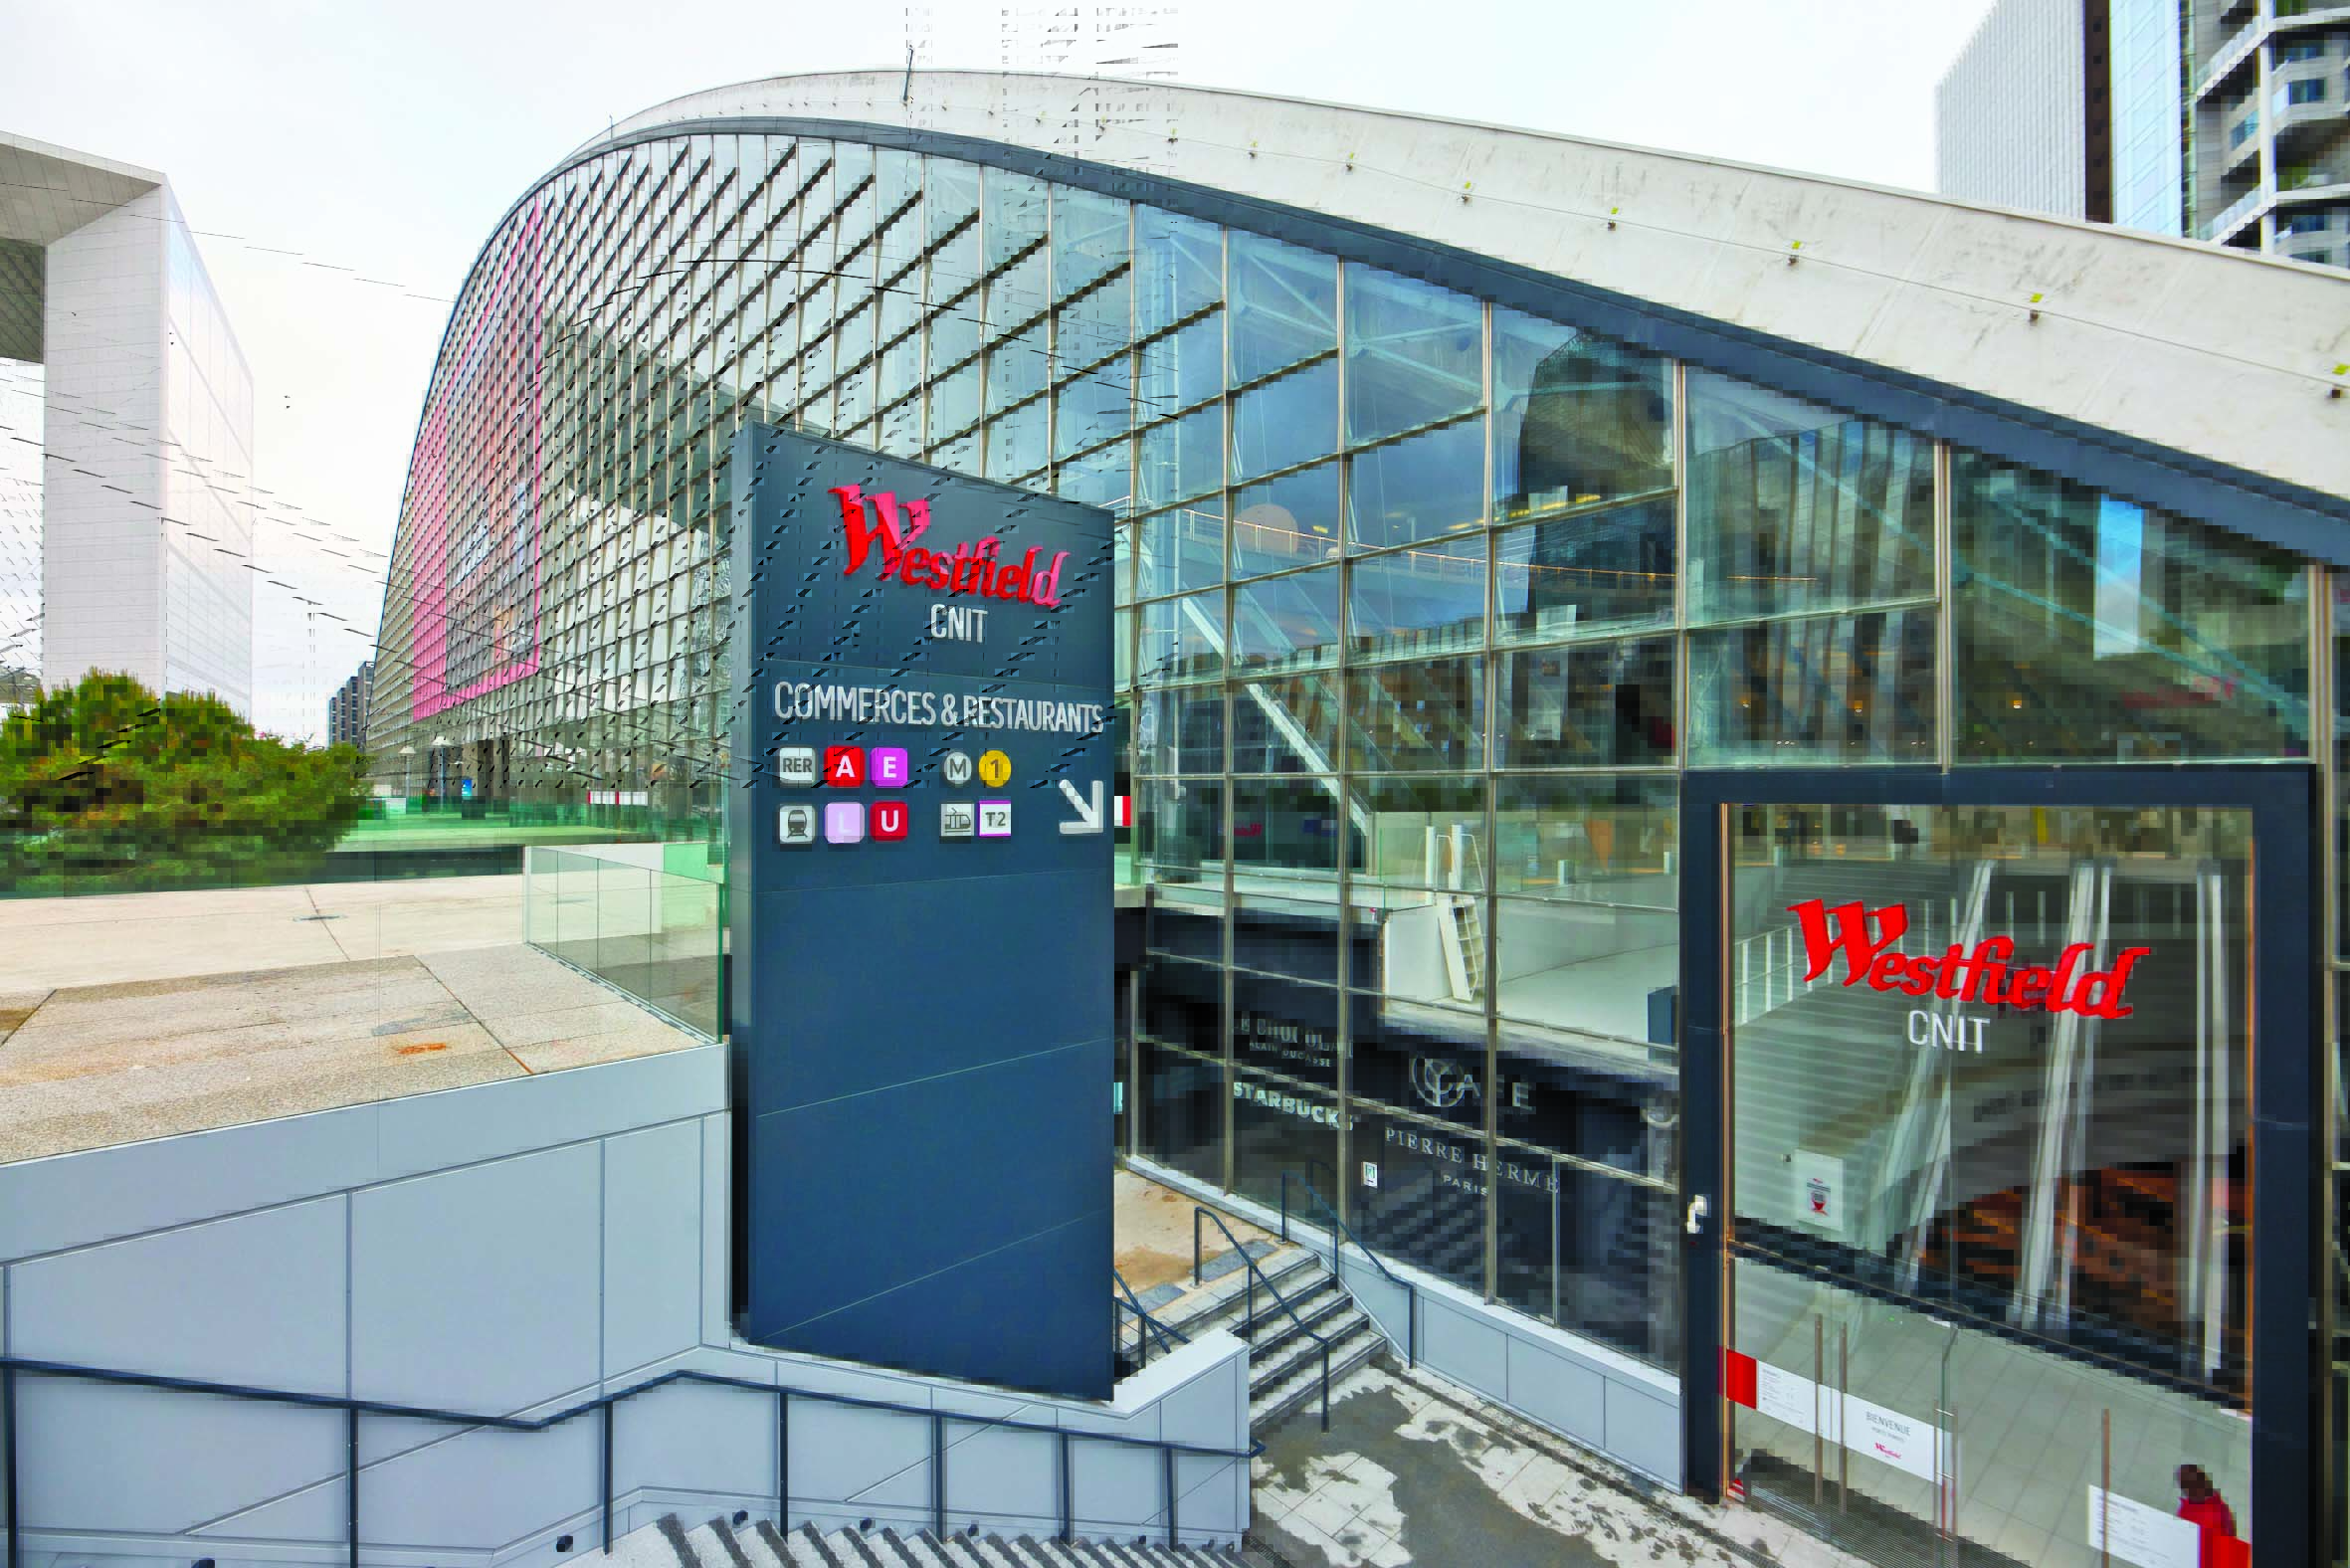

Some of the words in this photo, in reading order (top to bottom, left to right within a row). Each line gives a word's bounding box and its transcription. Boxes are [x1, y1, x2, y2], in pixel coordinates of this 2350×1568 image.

[827, 483, 1073, 609] Westfield
[929, 603, 988, 644] CNIT
[773, 680, 936, 726] COMMERCES
[940, 692, 957, 726] &
[962, 694, 1104, 734] RESTAURANTS
[782, 756, 813, 774] RER
[835, 755, 856, 779] A
[882, 755, 897, 779] E
[948, 757, 968, 778] M
[989, 757, 1001, 779] 1
[881, 810, 899, 834] U
[985, 810, 1007, 829] T2
[1785, 898, 2151, 1020] Westfield
[1907, 1009, 1990, 1055] CNIT
[1282, 1050, 1331, 1067] DUCASSE
[1385, 1126, 1464, 1164] PIERRE
[1443, 1174, 1488, 1196] PARIS
